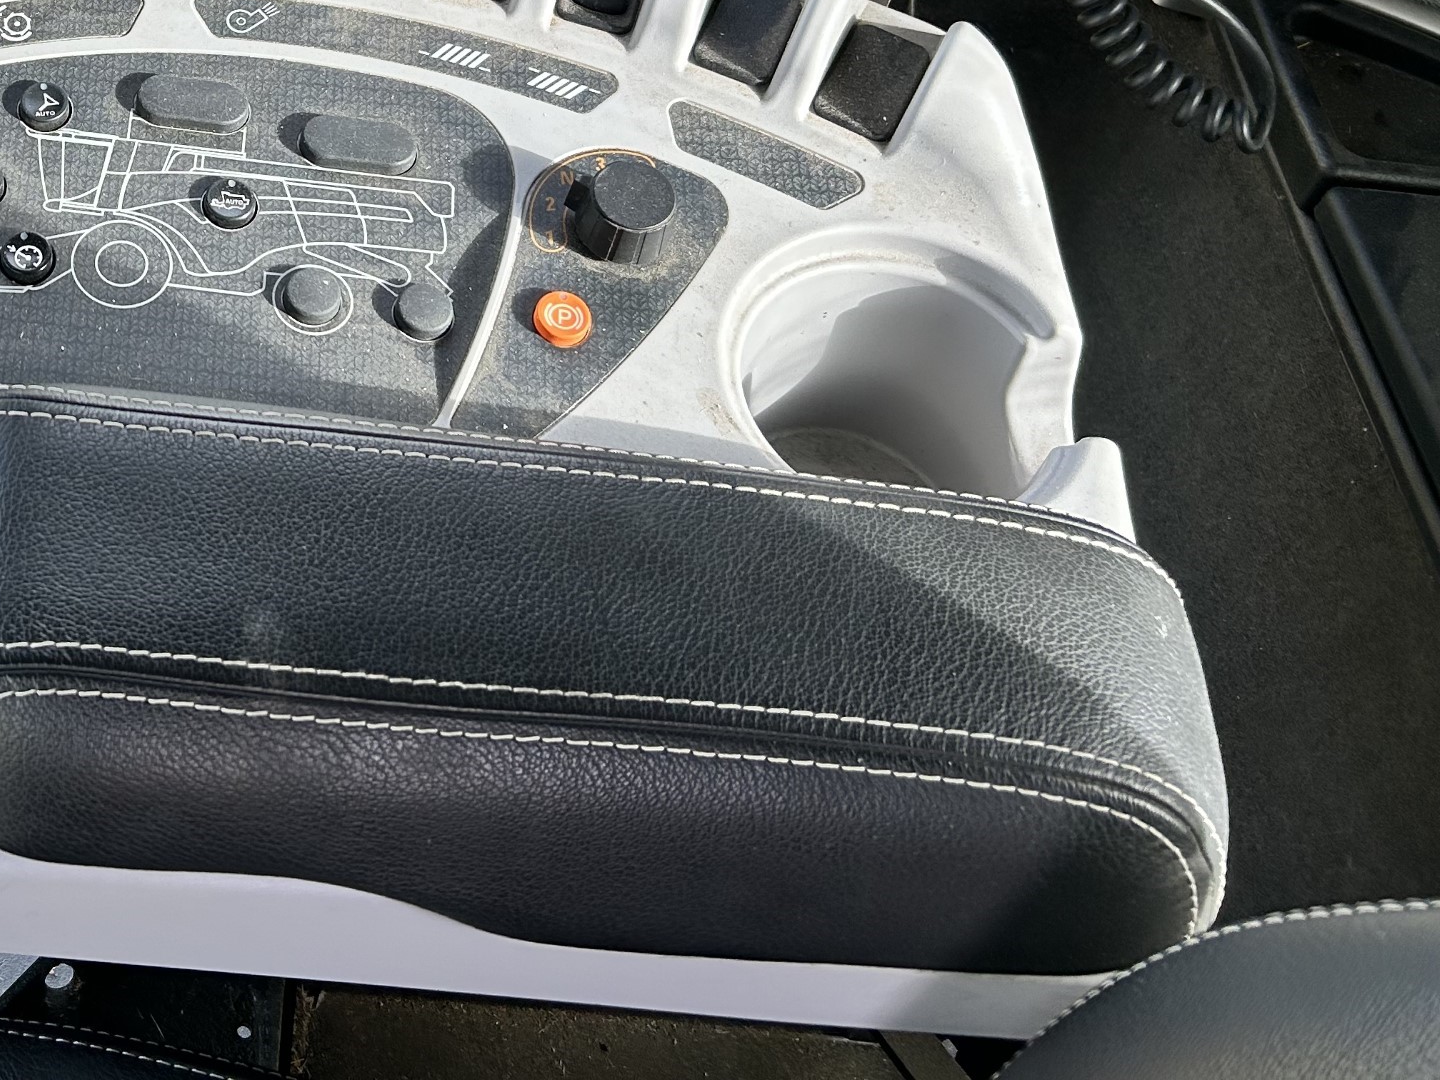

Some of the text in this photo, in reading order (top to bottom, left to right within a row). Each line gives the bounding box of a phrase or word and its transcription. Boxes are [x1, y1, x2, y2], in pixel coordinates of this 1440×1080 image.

[596, 157, 607, 171] 3
[560, 171, 575, 186] N
[225, 198, 244, 206] AUTO
[545, 196, 556, 212] 2
[558, 308, 573, 325] P
